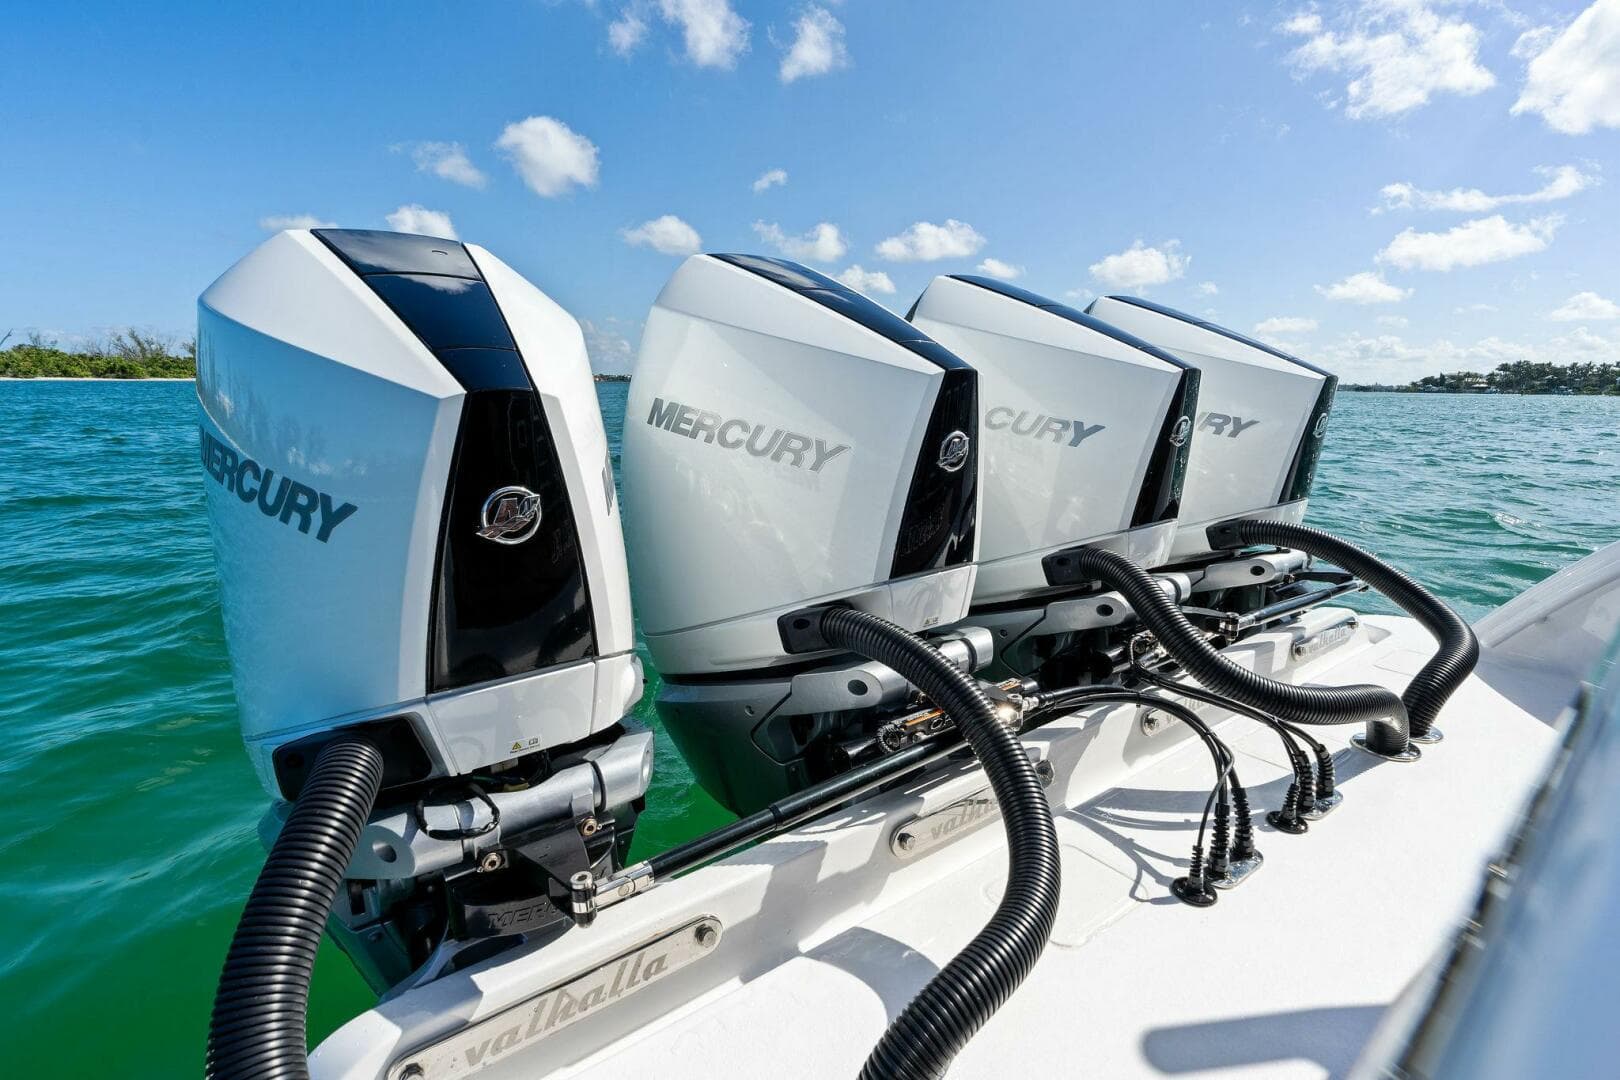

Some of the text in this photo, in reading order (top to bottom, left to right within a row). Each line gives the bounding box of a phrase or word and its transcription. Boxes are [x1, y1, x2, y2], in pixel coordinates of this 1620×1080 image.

[200, 425, 359, 543] MERCURY
[647, 397, 851, 474] MERCURY
[464, 950, 669, 1067] valhalla
